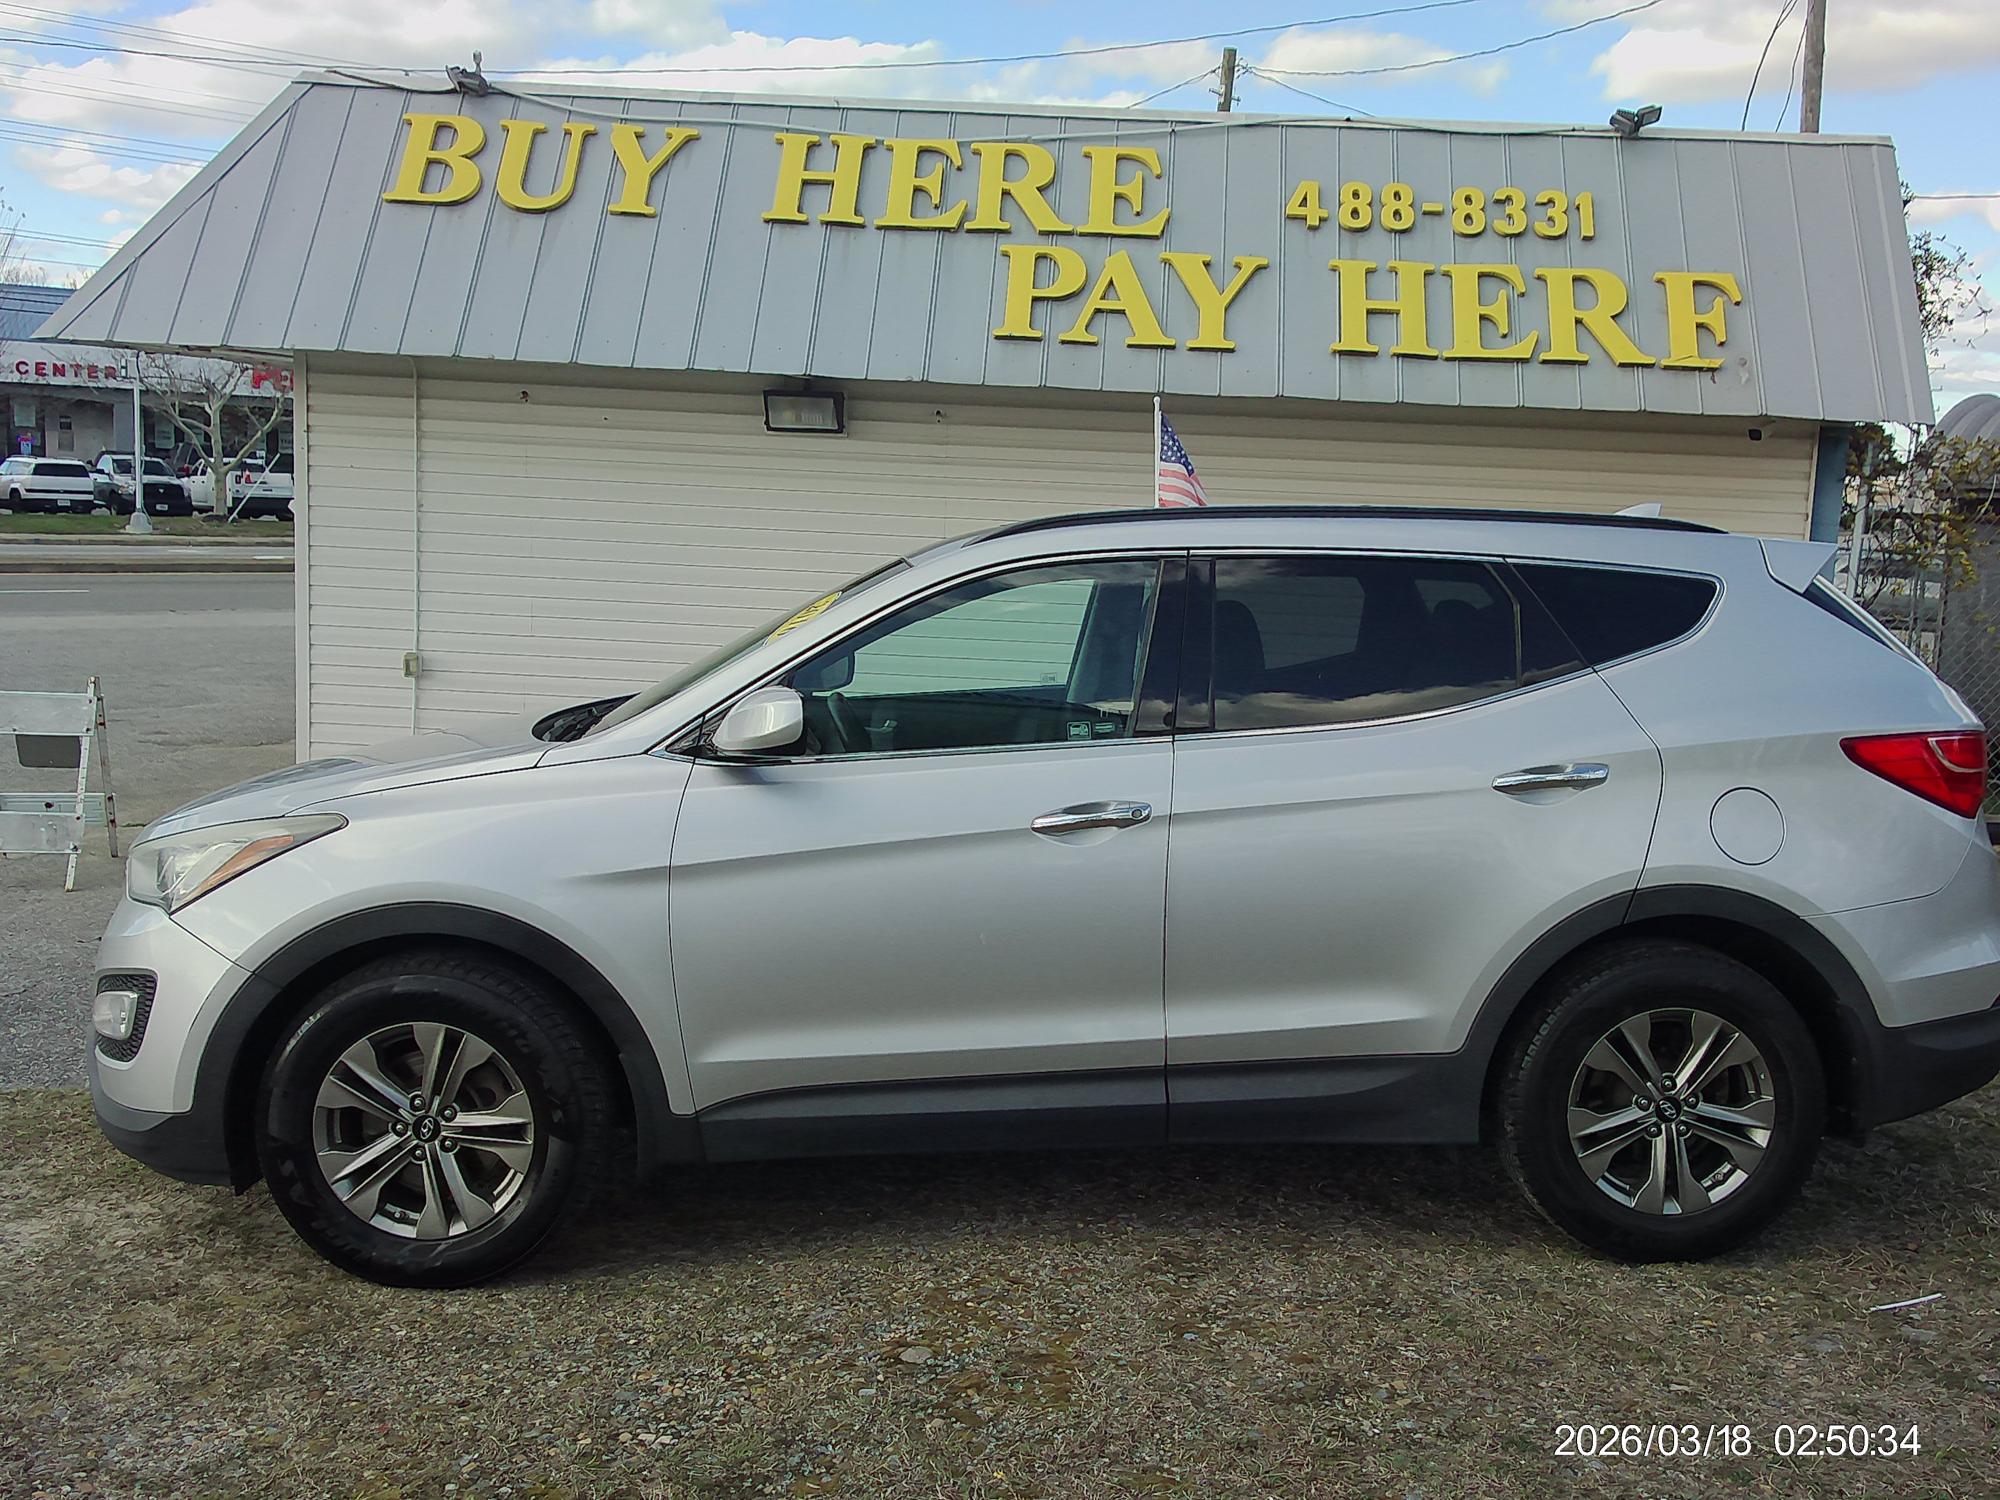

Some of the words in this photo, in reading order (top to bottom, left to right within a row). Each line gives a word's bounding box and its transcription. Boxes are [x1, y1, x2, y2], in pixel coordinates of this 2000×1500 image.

[383, 114, 700, 217] BUY
[762, 133, 1171, 238] HERE
[1286, 181, 1596, 239] 488-8331
[992, 244, 1270, 351] PAY
[15, 361, 118, 379] CENTER
